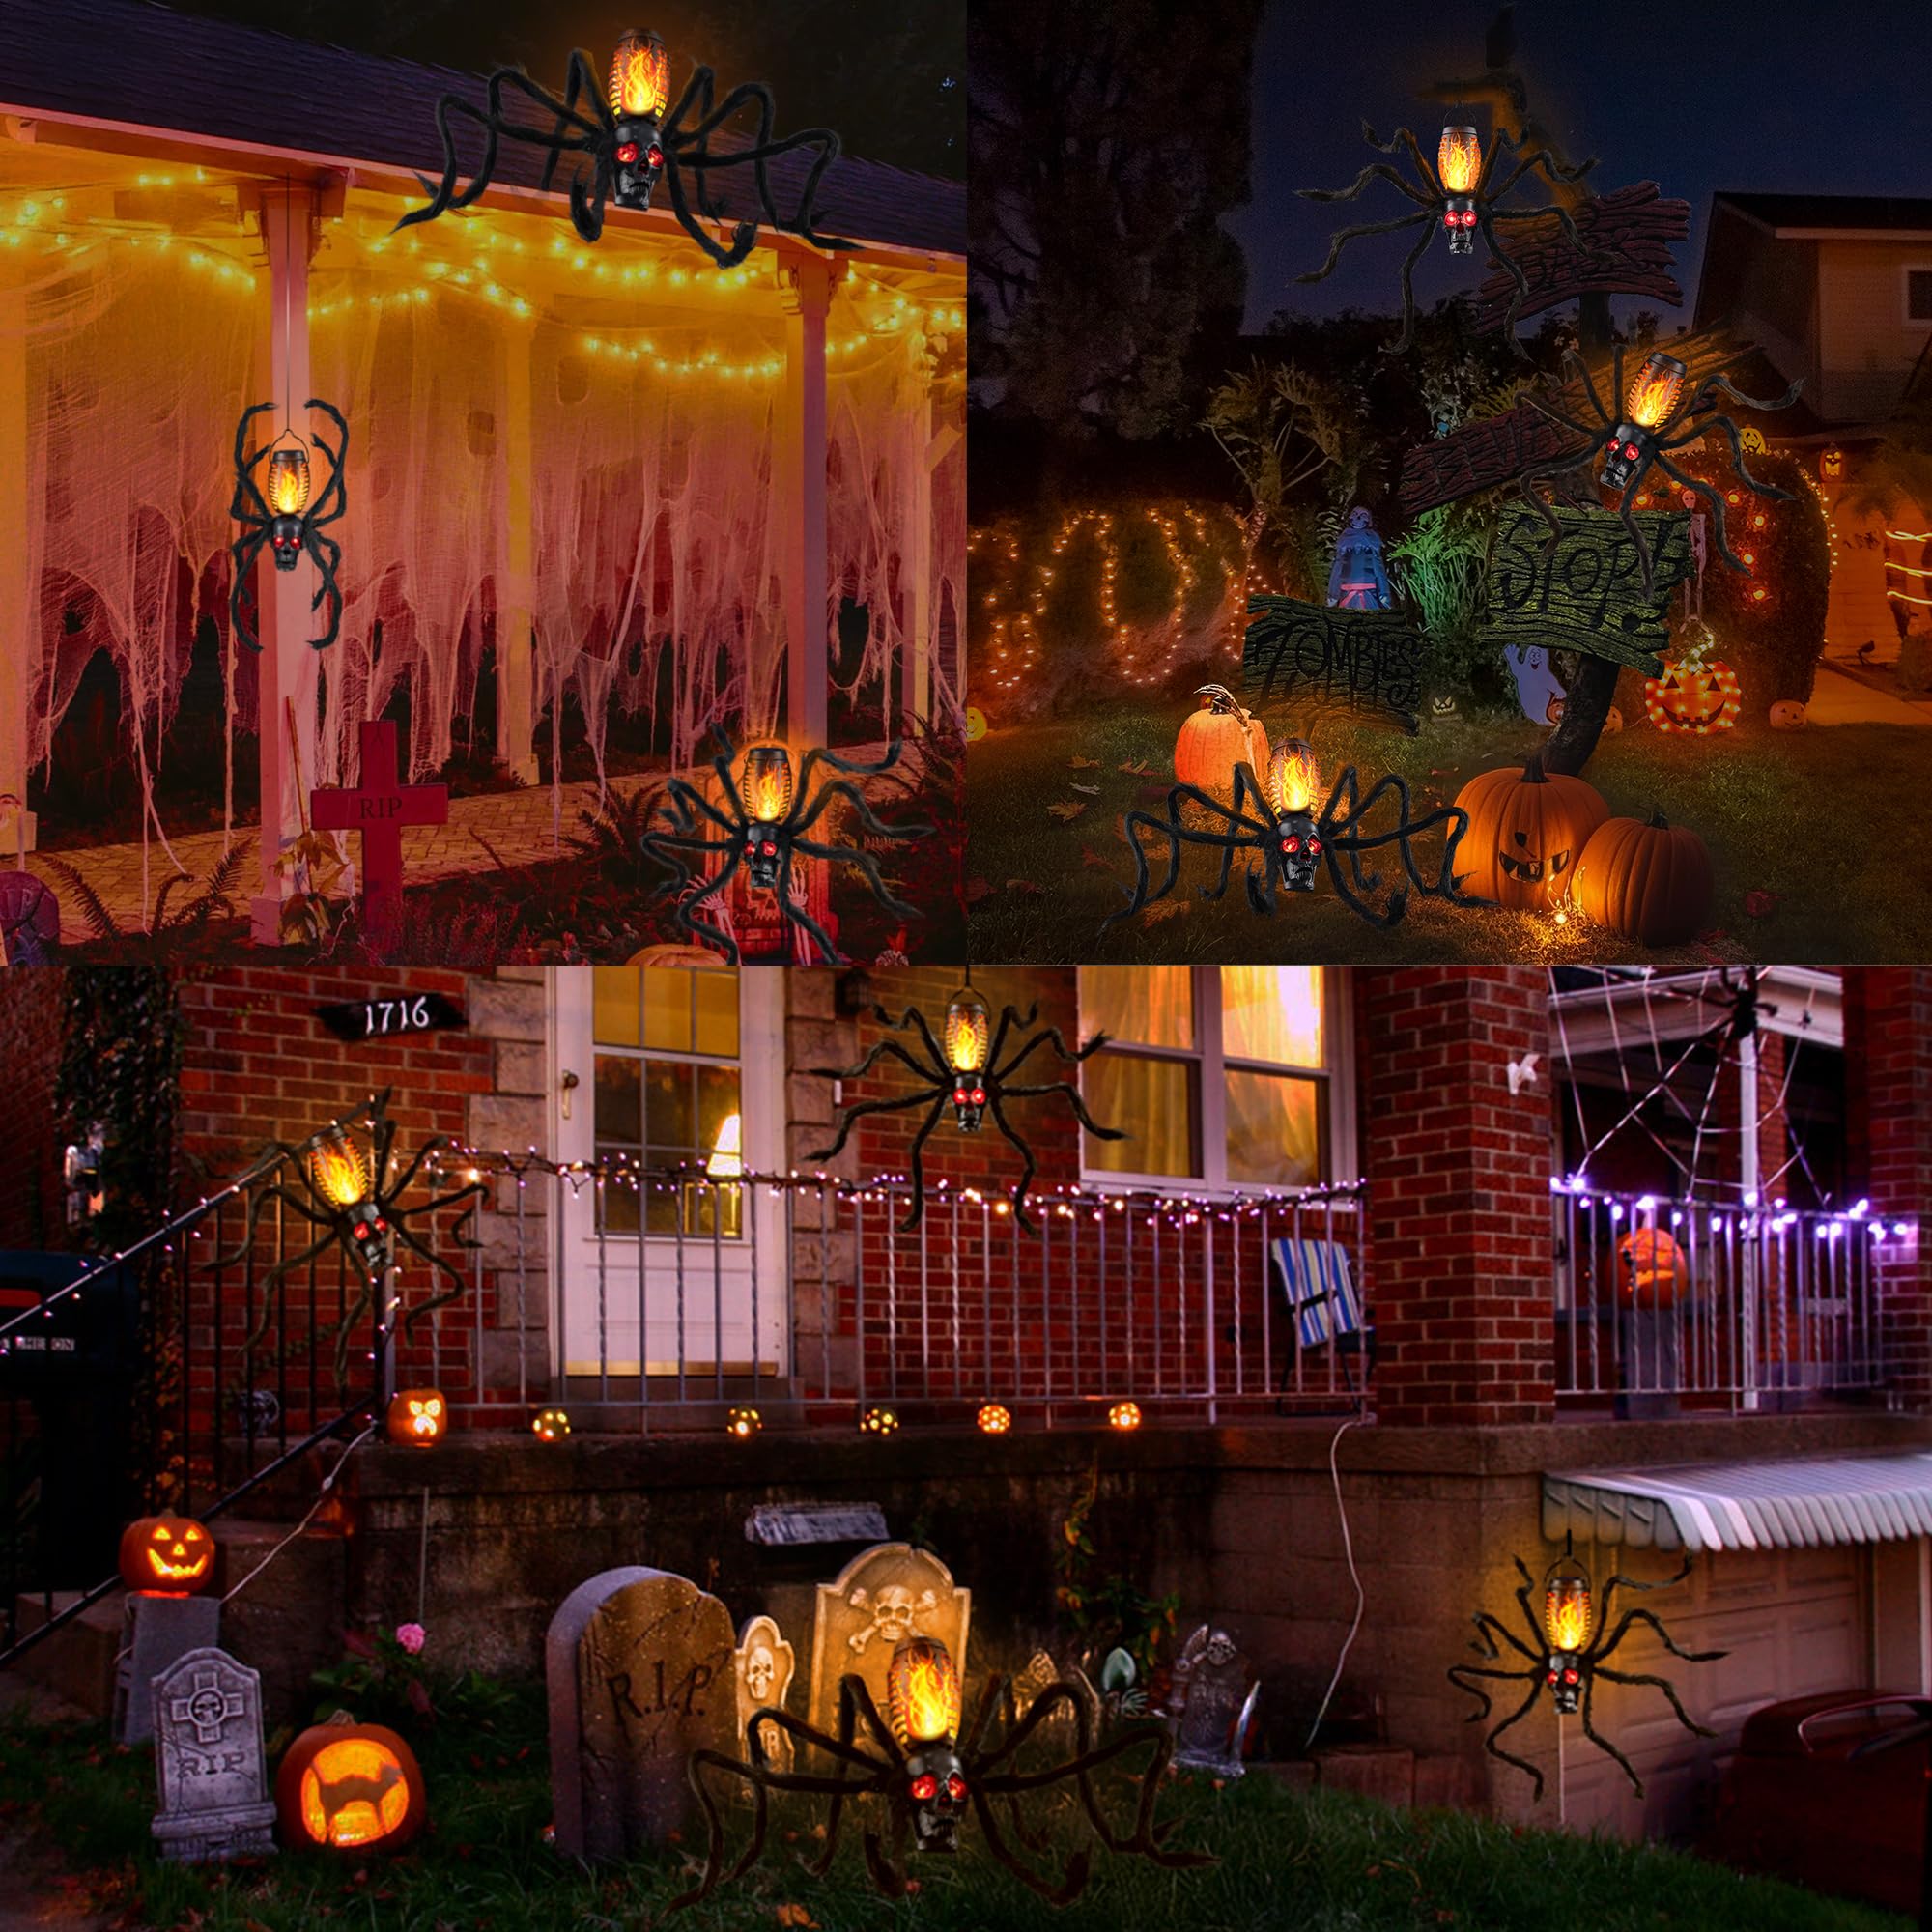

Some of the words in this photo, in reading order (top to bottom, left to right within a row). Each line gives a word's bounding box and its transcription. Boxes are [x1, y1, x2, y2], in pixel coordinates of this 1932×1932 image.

[360, 796, 403, 820] RIP
[365, 995, 430, 1036] 1716
[606, 1659, 713, 1719] R.I.P.
[176, 1751, 245, 1778] RIP
